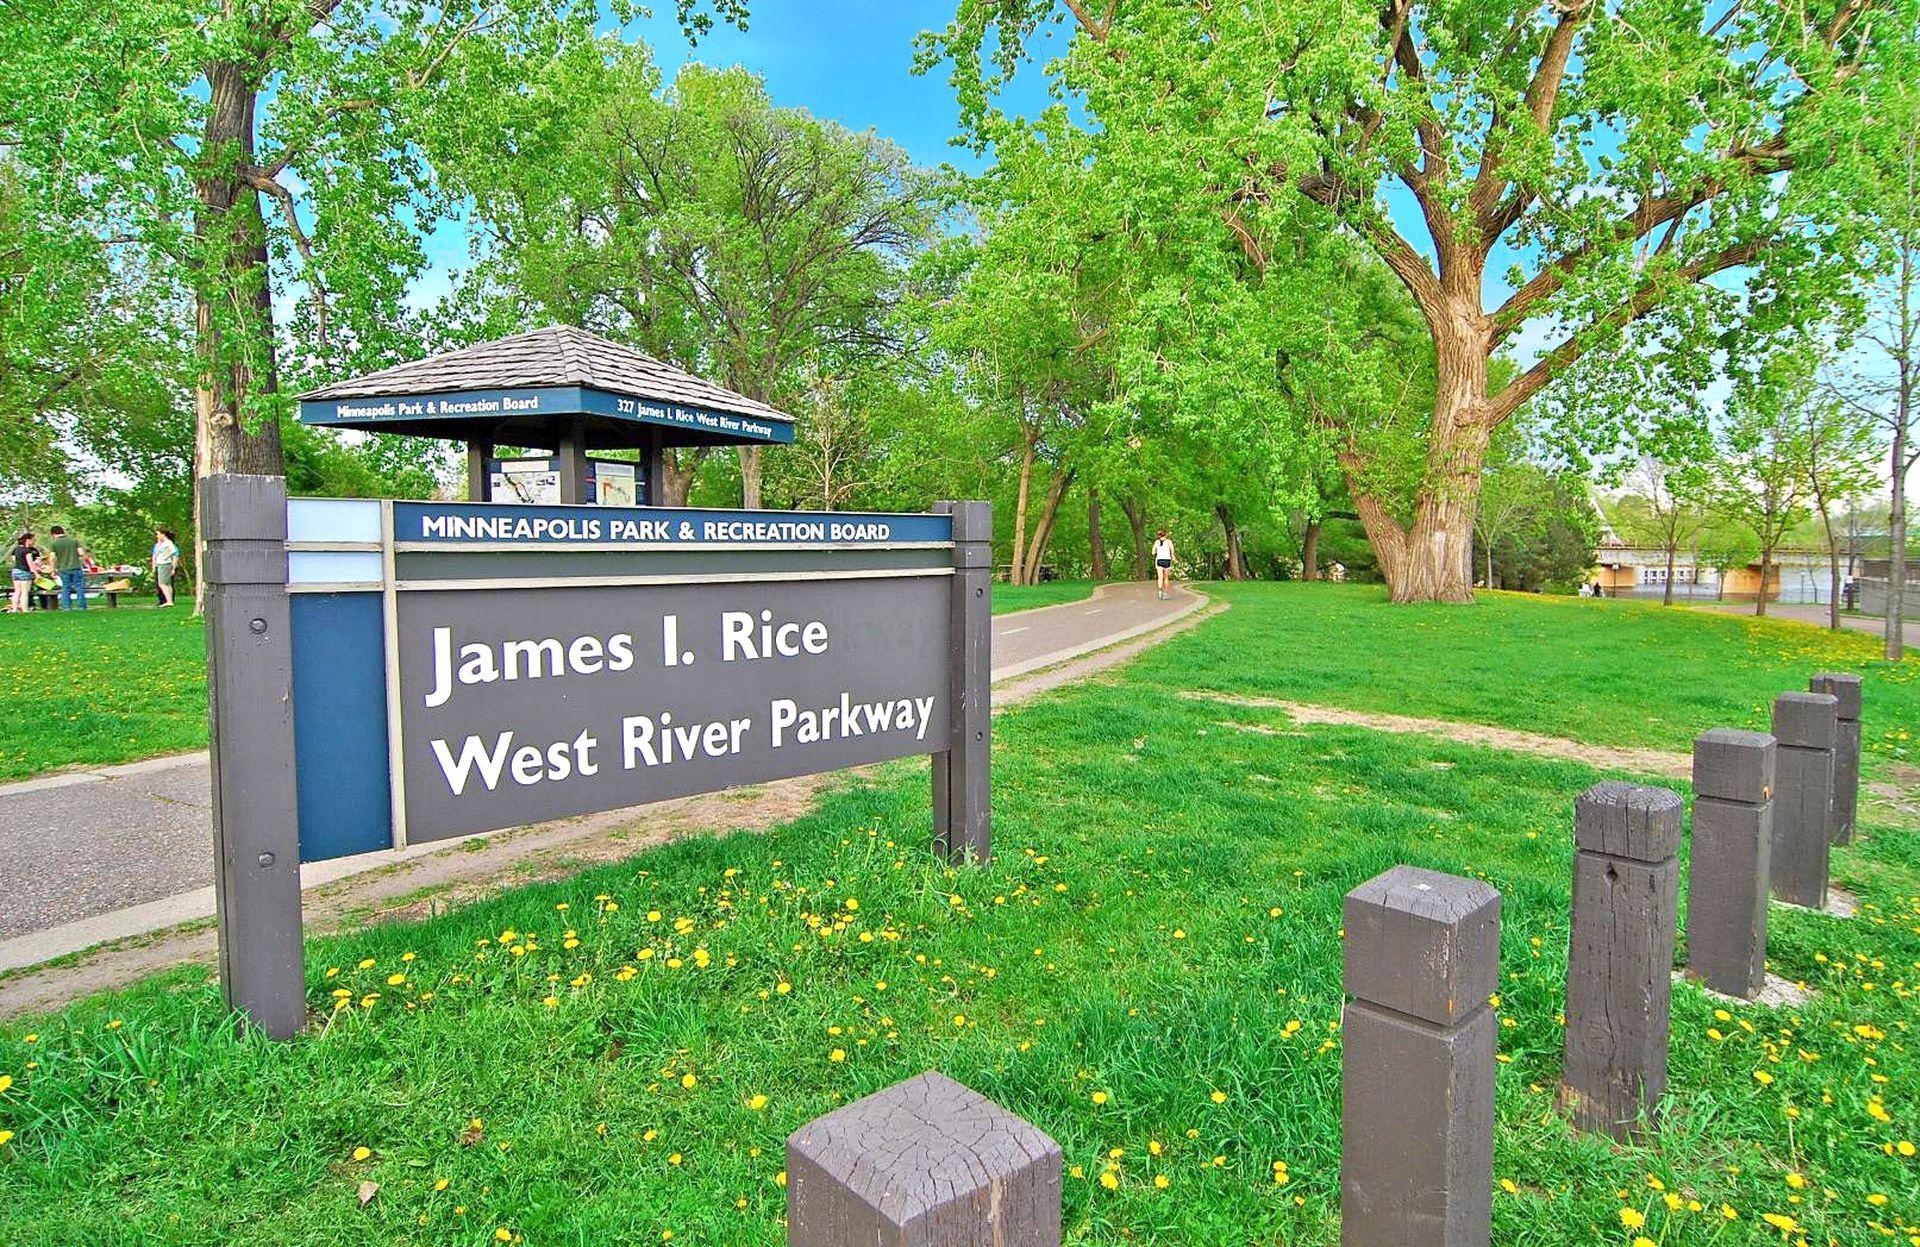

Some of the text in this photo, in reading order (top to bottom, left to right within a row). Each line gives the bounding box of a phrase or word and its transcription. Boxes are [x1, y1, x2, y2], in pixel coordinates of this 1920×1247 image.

[337, 396, 539, 419] Minneapolis Park & Recreation Board
[617, 399, 634, 414] 327
[637, 402, 664, 418] James
[676, 409, 694, 423] Rice
[696, 413, 719, 427] West
[719, 415, 740, 430] River
[741, 421, 772, 439] Parkway
[422, 515, 890, 541] MINNEAPOLIS PARK & RECREATION BOARD
[424, 609, 829, 708] James I. Rice
[431, 692, 934, 796] West River Parkway
